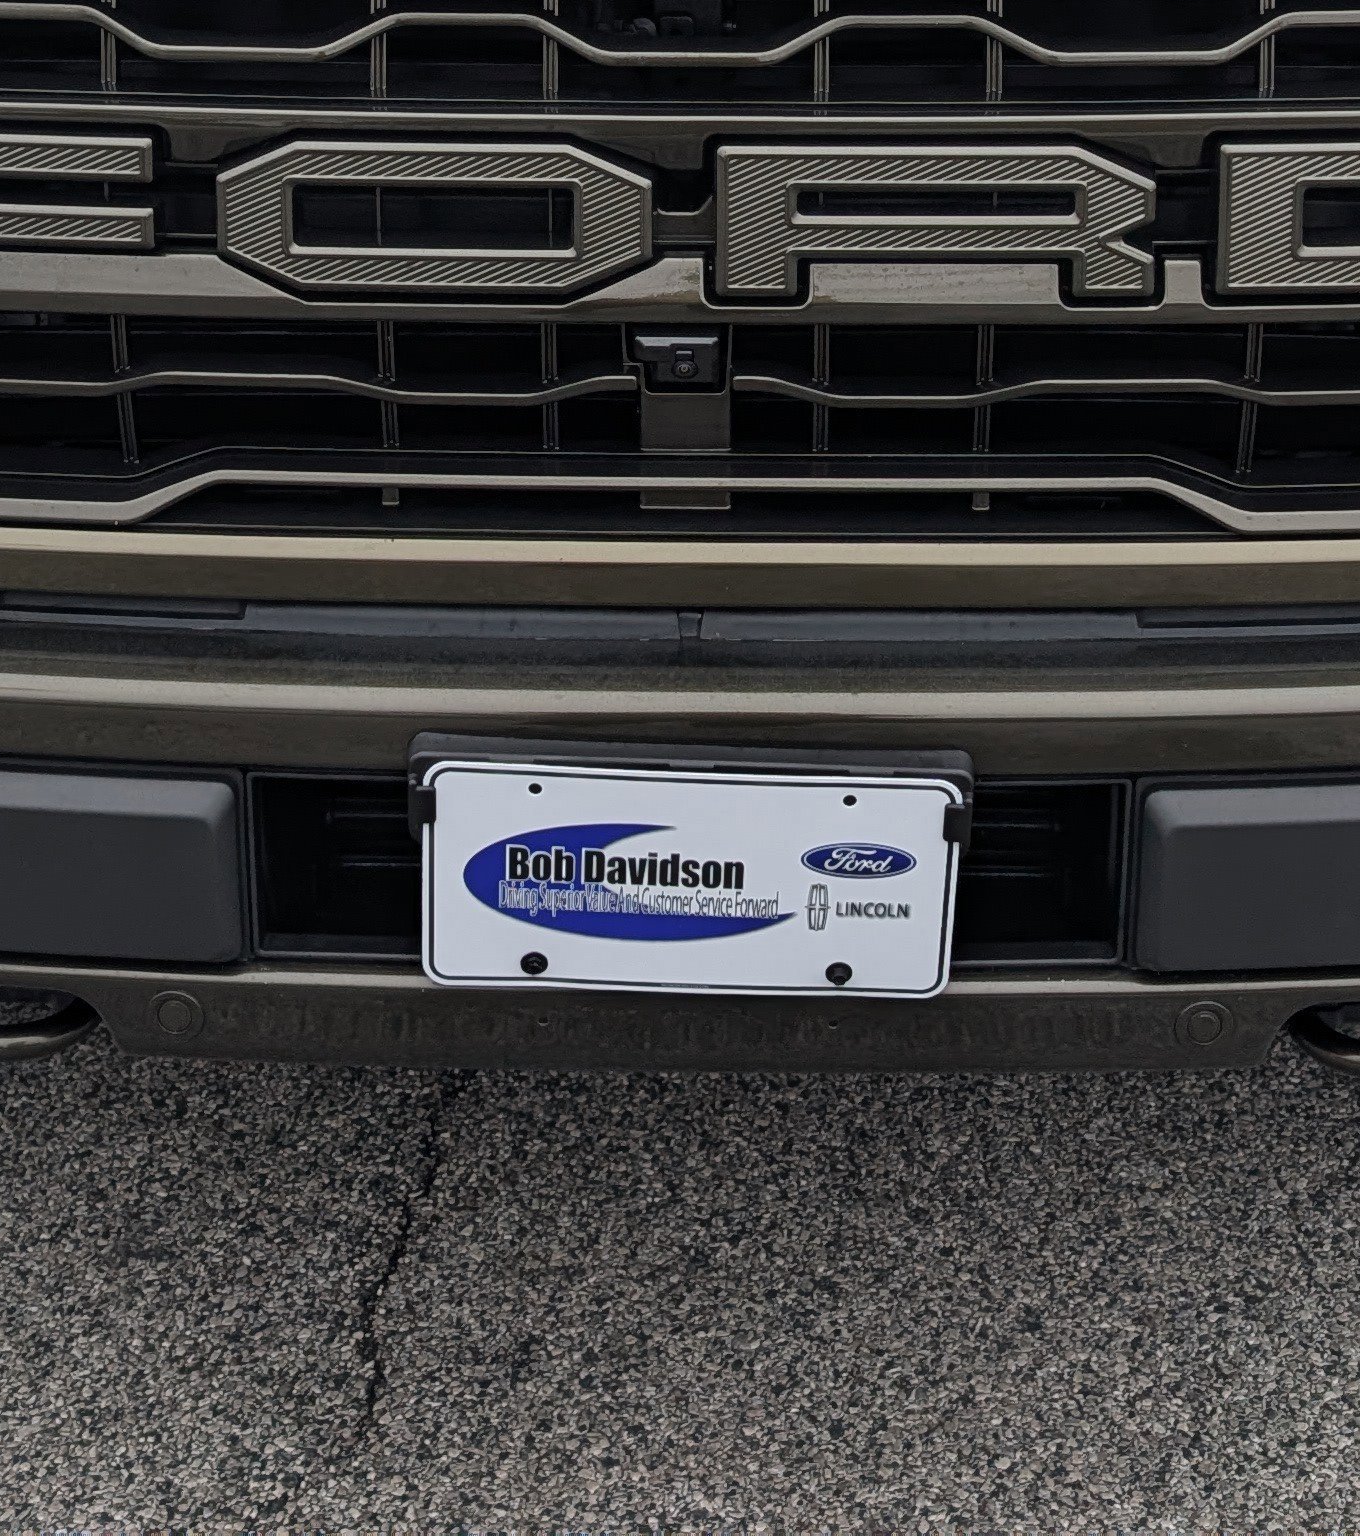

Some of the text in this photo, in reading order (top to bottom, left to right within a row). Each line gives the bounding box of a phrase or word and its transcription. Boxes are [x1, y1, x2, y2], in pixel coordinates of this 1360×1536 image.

[507, 845, 746, 889] Bob Davidson
[823, 847, 894, 873] Ford
[498, 880, 779, 919] Driving Superior Value And Customer Service Forward
[835, 901, 911, 919] LINCOLN
